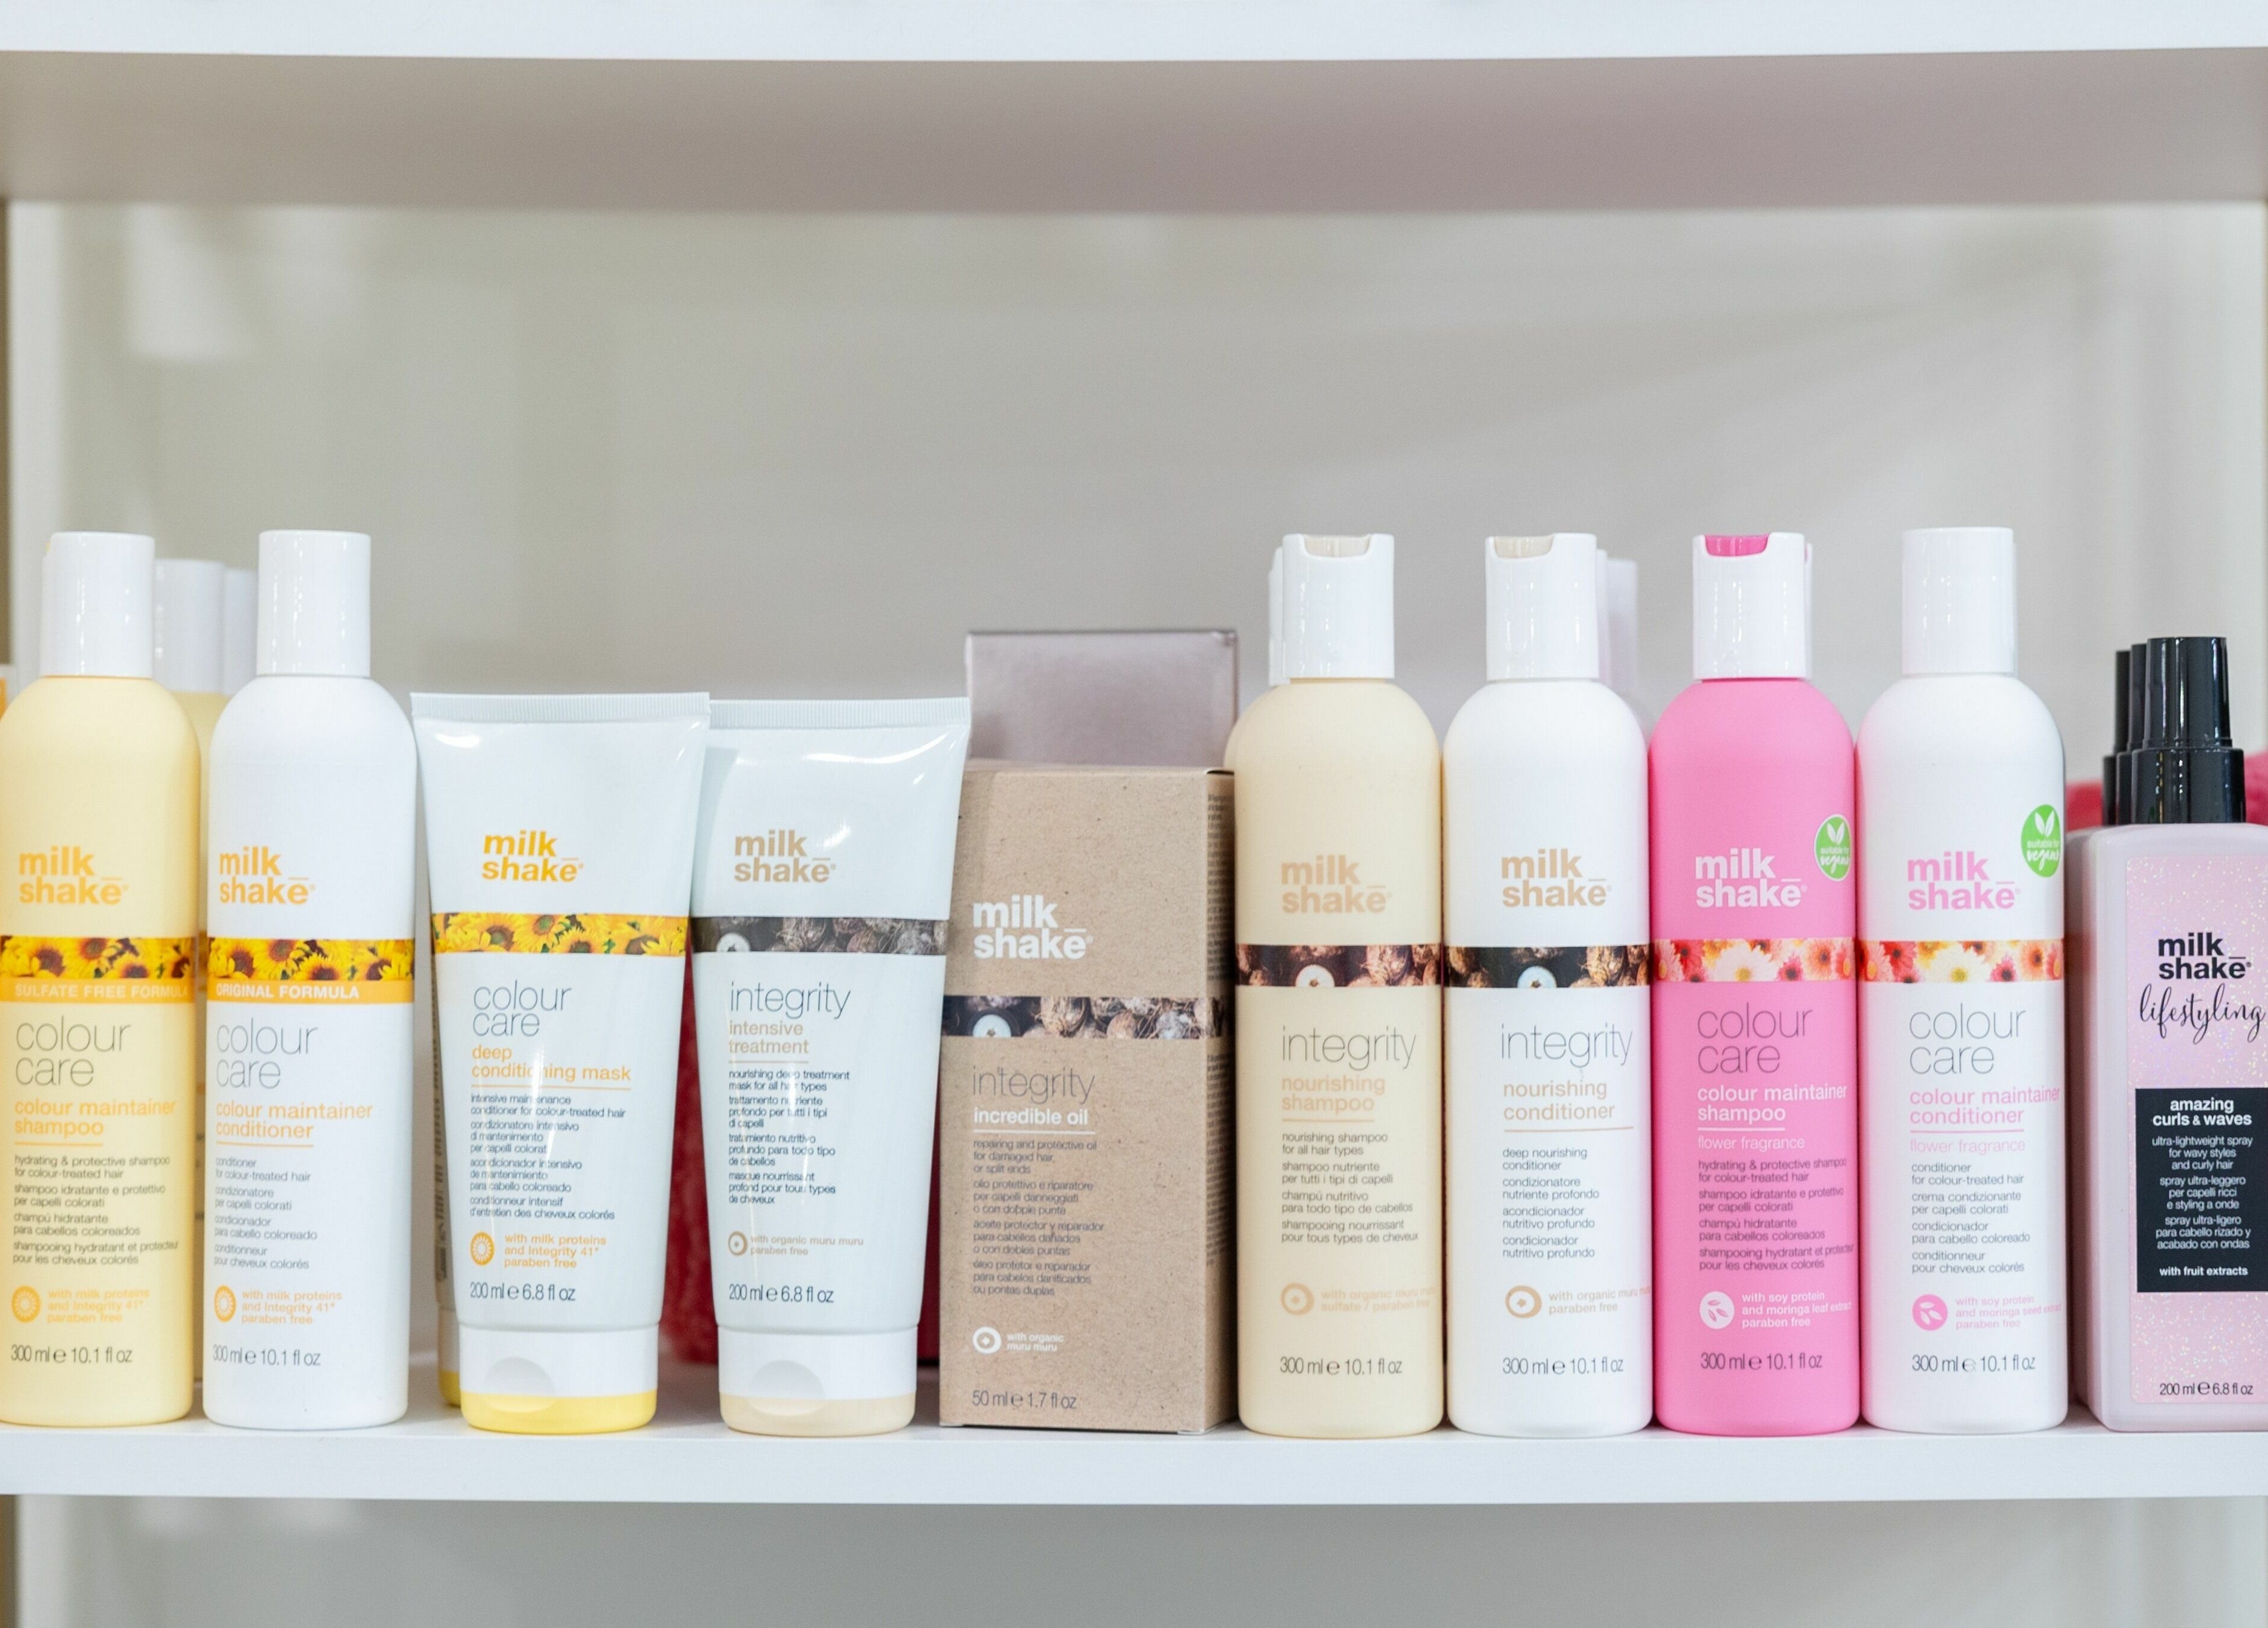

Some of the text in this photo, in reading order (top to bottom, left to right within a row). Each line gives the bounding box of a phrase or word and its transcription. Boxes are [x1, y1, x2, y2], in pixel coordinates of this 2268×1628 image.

[483, 830, 557, 857] milk
[734, 829, 807, 857] milk
[19, 845, 94, 876] milk
[219, 845, 281, 876] milk
[1281, 854, 1361, 885] milk
[1501, 848, 1582, 879] milk
[1695, 847, 1776, 879] milk
[1907, 850, 1989, 882] milk
[972, 894, 1058, 928] milk
[2158, 932, 2224, 956] milk
[14, 983, 78, 997] SULFATE
[83, 984, 125, 997] FREE
[216, 983, 360, 998] ORIGINAL FORMULA
[473, 979, 572, 1011] colour
[731, 981, 851, 1020] integrity
[1697, 1001, 1813, 1040] colour
[1909, 1002, 2026, 1040] colour
[2140, 983, 2266, 1044] lifestyling
[16, 1015, 131, 1053] colour
[472, 1012, 540, 1037] care
[729, 1020, 803, 1036] intensive
[217, 1017, 318, 1055] colour
[1501, 1022, 1633, 1069] integrity
[471, 1044, 512, 1062] deep
[728, 1039, 809, 1054] treatment
[1282, 1025, 1417, 1071] integrity
[1698, 1045, 1781, 1074] care
[1910, 1046, 1994, 1075] care
[16, 1057, 94, 1087] care
[216, 1059, 281, 1090] care
[582, 1065, 631, 1081] mask
[973, 1065, 1095, 1105] integrity
[1281, 1074, 1386, 1096] nourishing
[1503, 1079, 1607, 1100] nourishing
[1697, 1083, 1847, 1102] colour maintainer
[1281, 1094, 1375, 1115] shampoo
[1910, 1086, 2061, 1105] colour maintainer
[14, 1098, 176, 1116] colour maintainer
[216, 1100, 373, 1119] colour maintainer
[1503, 1103, 1615, 1121] conditioner
[1698, 1104, 1786, 1125] shampoo
[1910, 1105, 2024, 1124] conditioner
[2169, 1097, 2234, 1114] amazing
[973, 1106, 1088, 1125] incredible oil
[2152, 1112, 2252, 1126] curls & waves
[14, 1118, 105, 1138] shampoo
[216, 1120, 314, 1139] conditioner
[1282, 1132, 1388, 1145] nourishing shampoo
[1697, 1135, 1805, 1153] flower fragrance
[1910, 1138, 2025, 1156] flower fragrance
[2152, 1135, 2254, 1148] ultra-lightweight spray
[1282, 1143, 1364, 1157] for all hair types
[1502, 1147, 1588, 1160] deep nourishing
[2168, 1147, 2237, 1160] for wavy styles
[14, 1154, 170, 1169] hydrating & protective shampoo
[1502, 1160, 1562, 1170] conditioner
[1911, 1163, 1972, 1173] conditioner
[1502, 1177, 1581, 1188] condizionatore
[1911, 1174, 2024, 1185] for colour-treated hair
[1502, 1188, 1600, 1201] nutriente profondo
[2159, 1265, 2248, 1276] with fruit extracts
[242, 1290, 342, 1302] with milk proteins
[469, 1281, 489, 1299] 200
[522, 1283, 544, 1301] 6.8
[729, 1283, 748, 1301] 200
[781, 1285, 803, 1302] 6.8
[1742, 1290, 1825, 1305] with soy protein
[11, 1344, 32, 1362] 300
[71, 1346, 99, 1364] 10.1
[260, 1348, 287, 1366] 10.1
[1701, 1351, 1726, 1370] 300
[1766, 1353, 1793, 1371] 10.1
[1911, 1354, 1938, 1372] 300
[1980, 1355, 2007, 1372] 10.1
[1279, 1356, 1305, 1374] 300
[1345, 1358, 1372, 1376] 10.1
[1502, 1357, 1529, 1375] 300
[1570, 1357, 1596, 1375] 10.1
[972, 1389, 990, 1407] 50
[1028, 1391, 1047, 1408] 1.7
[2159, 1382, 2180, 1396] 200
[2212, 1382, 2230, 1396] 6.8
